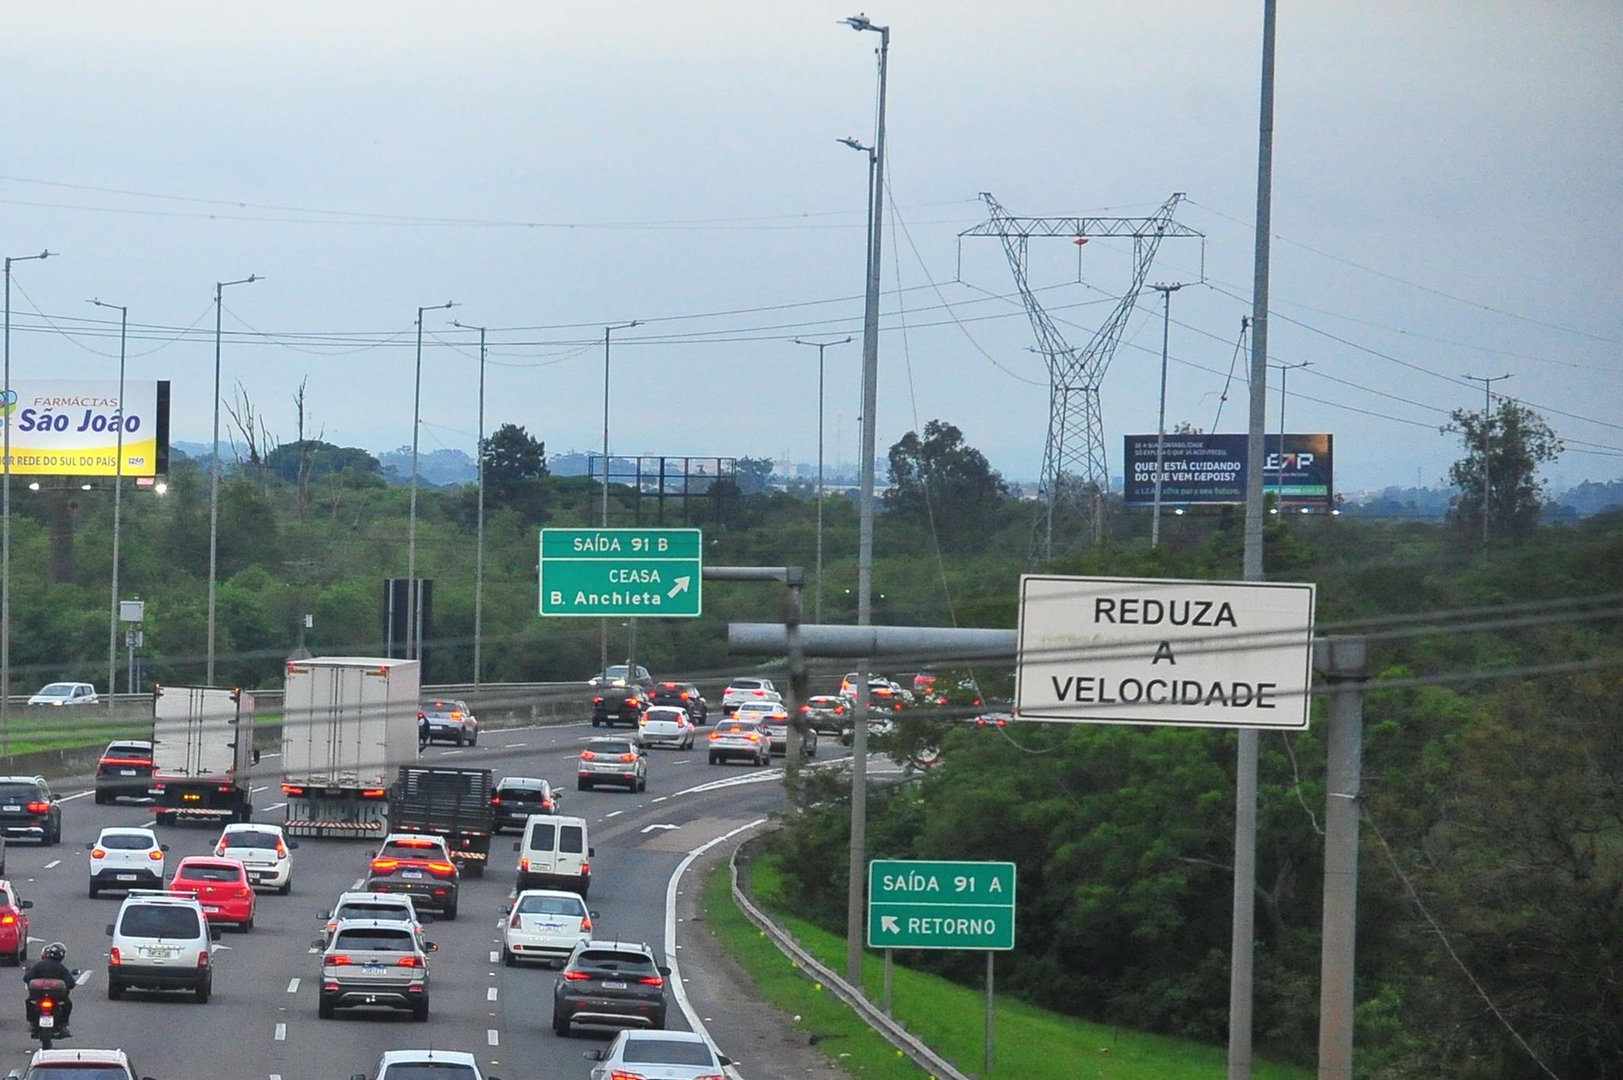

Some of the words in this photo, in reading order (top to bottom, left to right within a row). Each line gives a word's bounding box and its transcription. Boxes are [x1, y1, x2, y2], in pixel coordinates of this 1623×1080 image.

[33, 396, 118, 407] FARMÁCIAS
[18, 407, 69, 432] São
[77, 407, 141, 433] João
[17, 456, 41, 466] REDE
[43, 456, 57, 466] DO
[60, 456, 76, 466] SUL
[80, 456, 94, 466] DO
[96, 454, 117, 467] PAÍS
[1164, 460, 1188, 471] ESTÁ
[1190, 461, 1241, 471] CUIDANDO
[1135, 473, 1148, 481] DO
[1172, 473, 1192, 481] VEM
[1194, 472, 1236, 481] DEPOIS?
[573, 533, 621, 551] SAÍDA
[631, 538, 649, 551] 91
[657, 538, 668, 551] B
[609, 569, 661, 583] CEASA
[550, 591, 566, 605] B.
[574, 591, 661, 605] Anchieta
[1094, 598, 1237, 628] REDUZA
[1151, 640, 1176, 665] A
[1051, 675, 1277, 709] VELOCIDADE
[883, 870, 940, 891] SAÍDA
[954, 876, 975, 892] 91
[989, 877, 1002, 892] A
[908, 918, 996, 935] RETORNO
